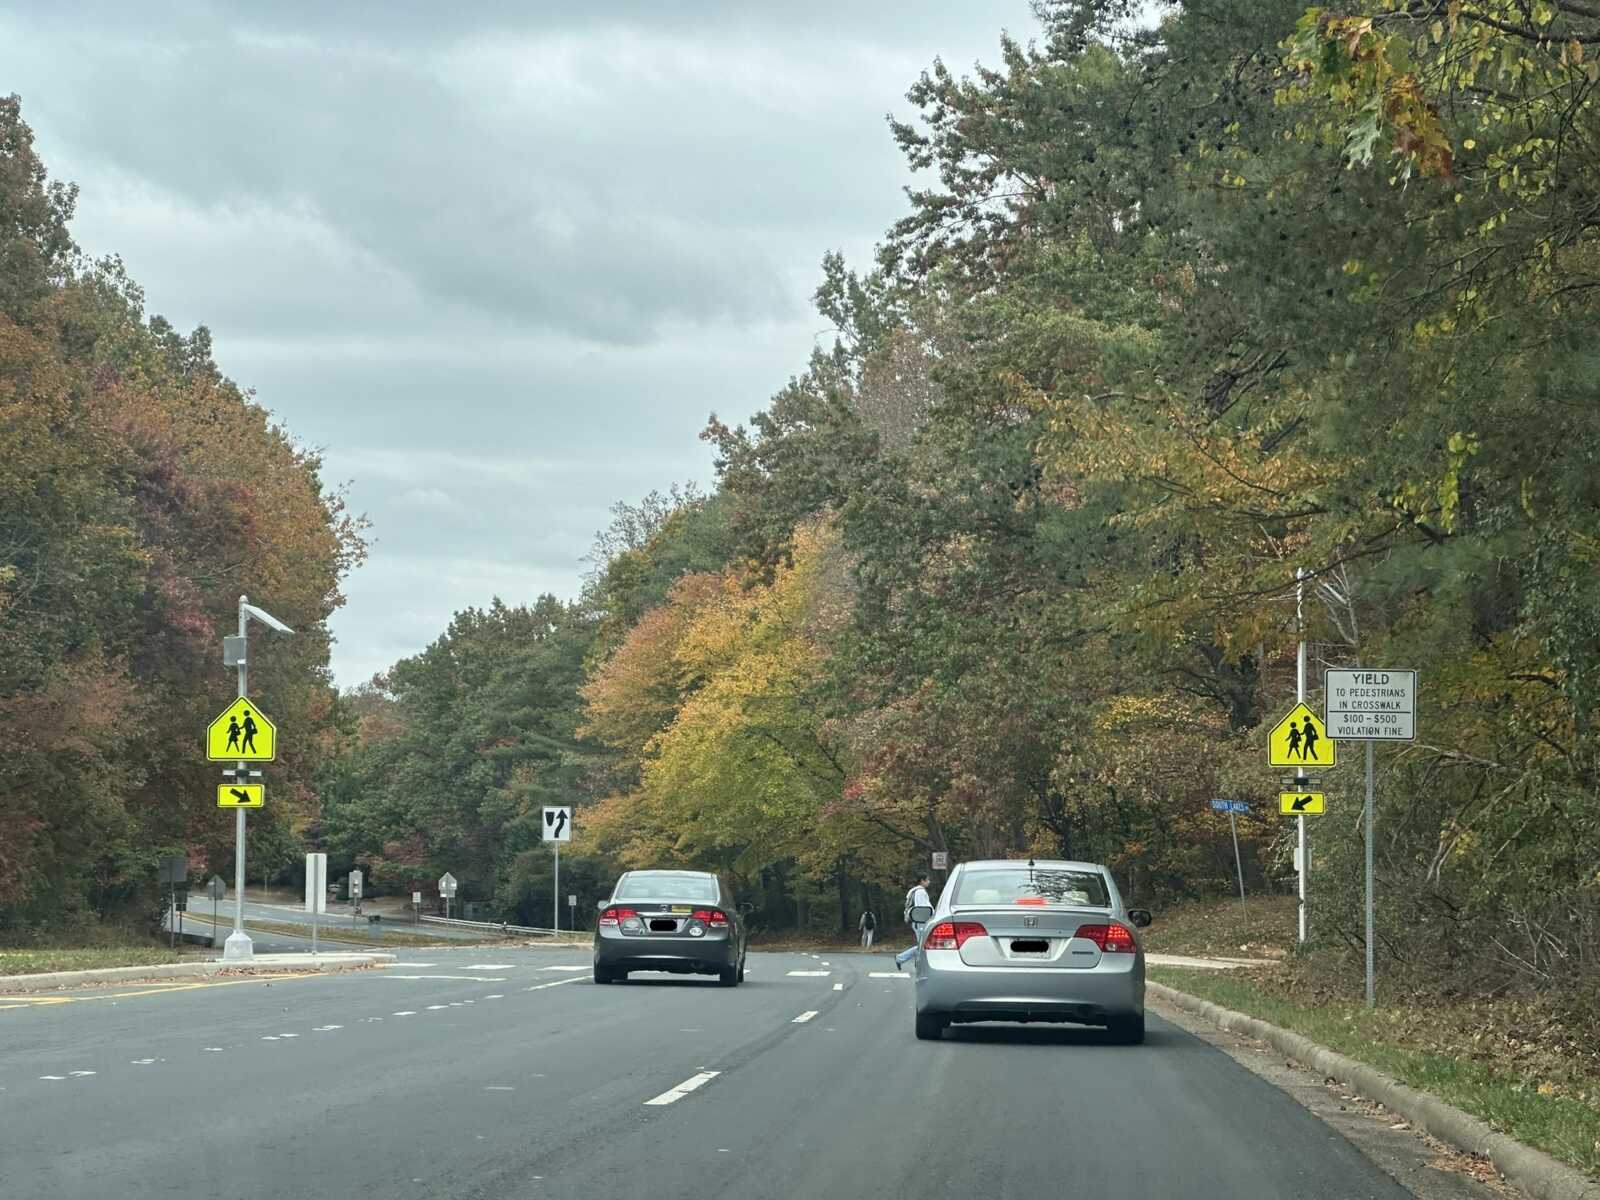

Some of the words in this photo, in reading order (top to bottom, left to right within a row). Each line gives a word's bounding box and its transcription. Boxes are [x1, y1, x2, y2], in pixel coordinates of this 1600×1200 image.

[1352, 673, 1389, 685] YIELD
[1336, 688, 1346, 697] TO
[1349, 688, 1406, 698] PEDESTRIANS
[1339, 701, 1348, 709] IN
[1351, 701, 1401, 710] CROSSWALK
[1337, 726, 1380, 736] VIOLATION
[1384, 727, 1403, 736] FINE
